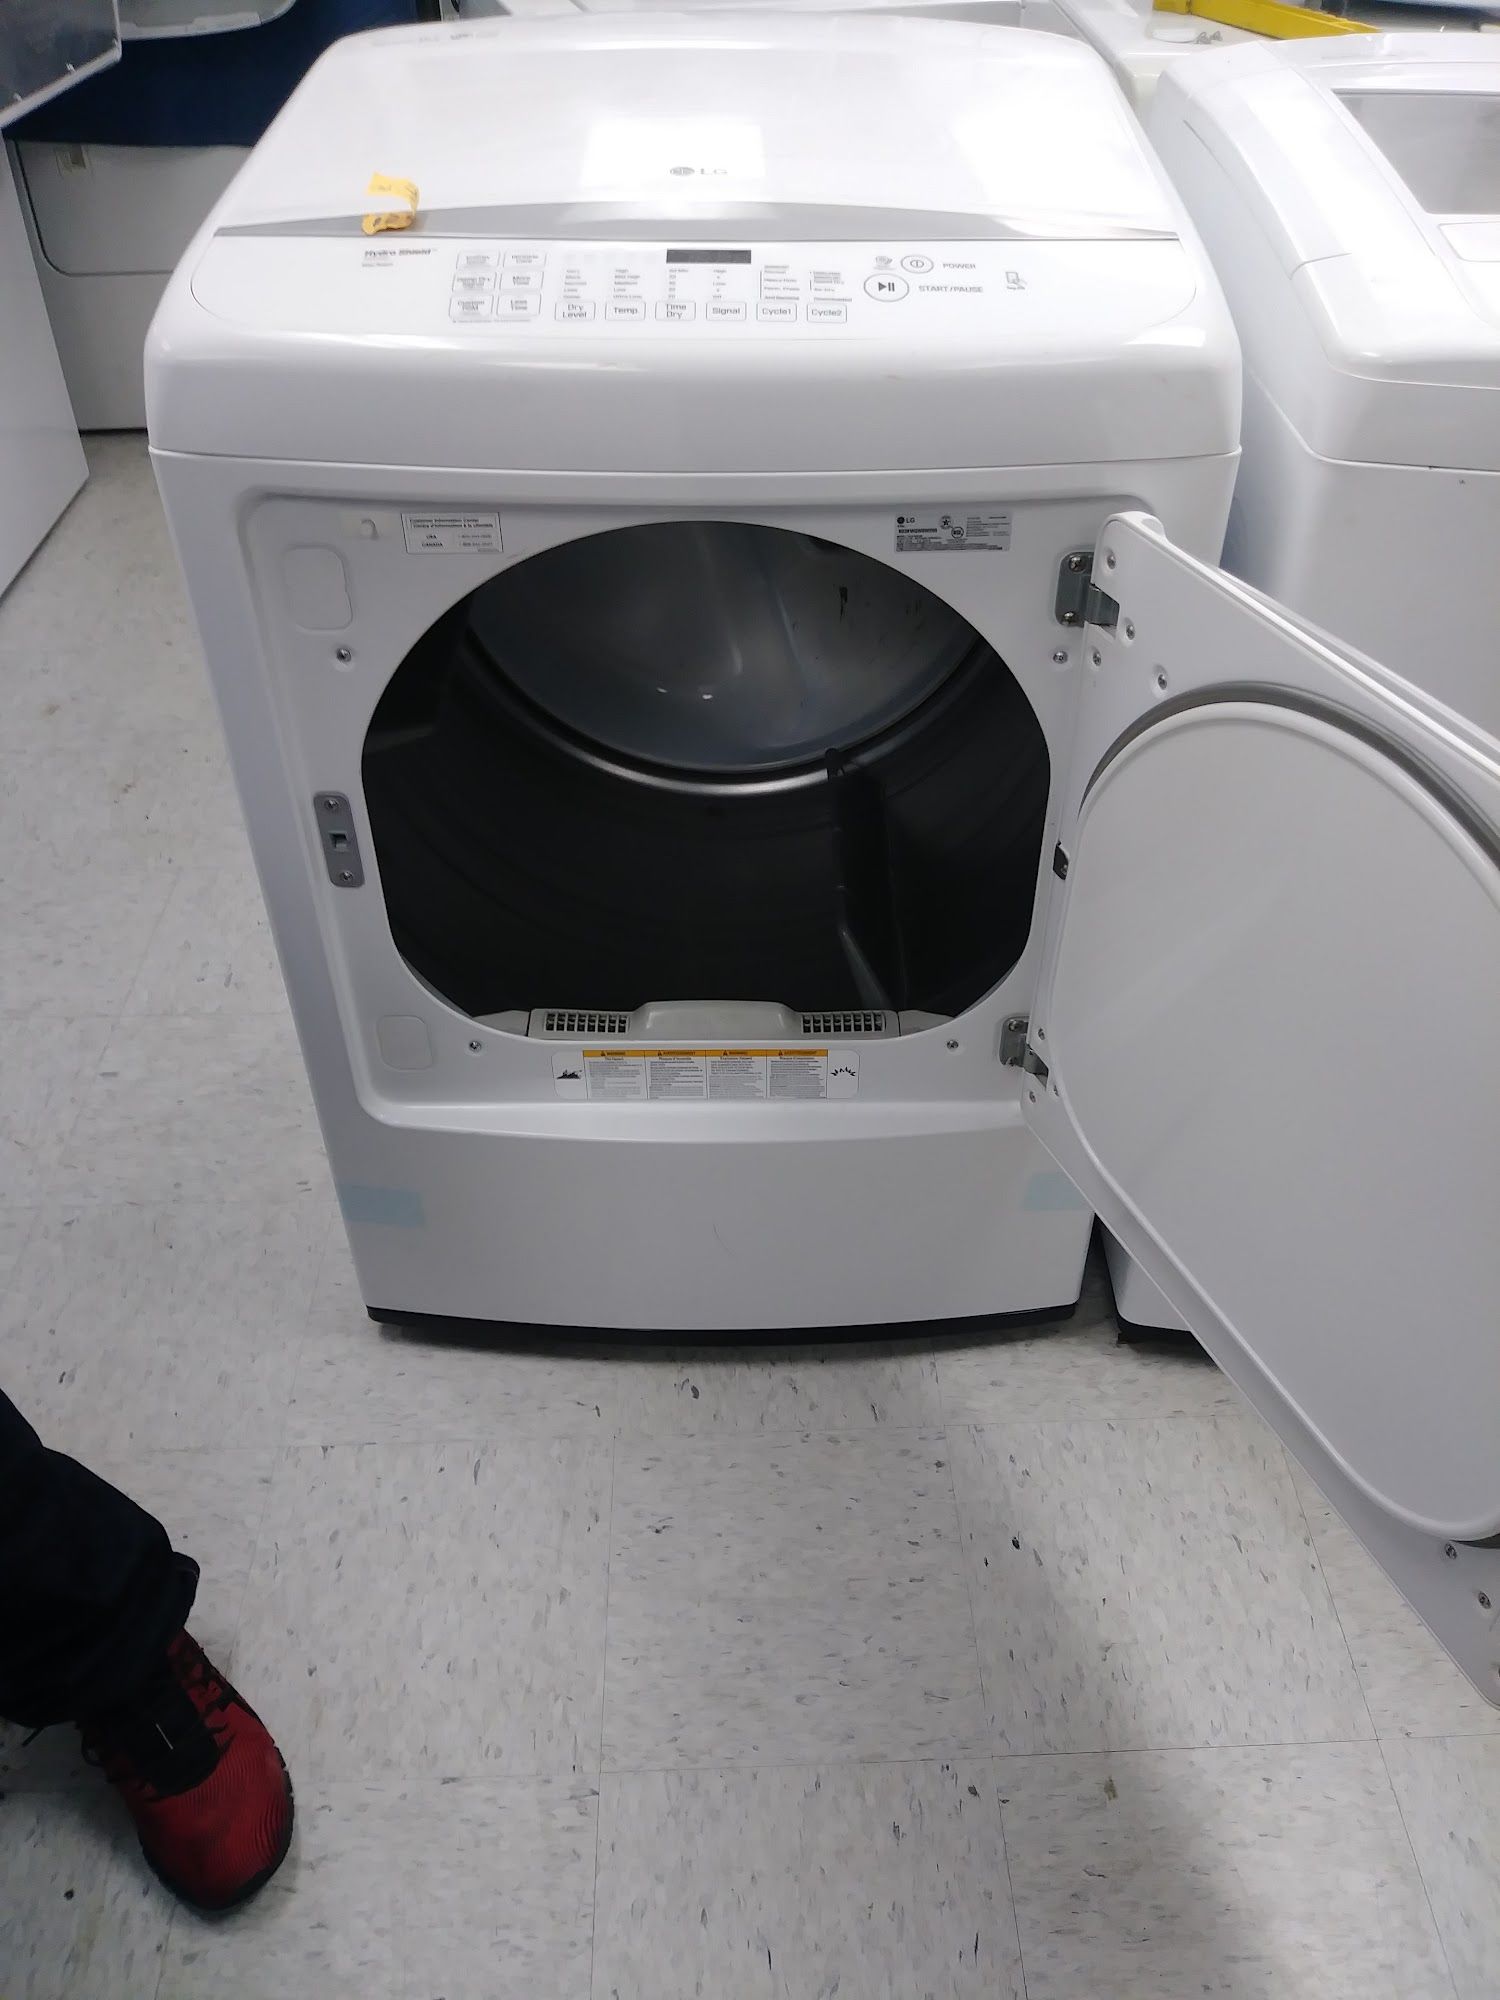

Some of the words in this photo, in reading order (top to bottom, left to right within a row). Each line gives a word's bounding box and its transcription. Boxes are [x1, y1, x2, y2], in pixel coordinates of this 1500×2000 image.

[700, 168, 728, 176] LG
[943, 262, 976, 270] POWER
[918, 284, 984, 294] START/PAUSE
[567, 303, 584, 312] Dry
[665, 303, 687, 311] Time
[711, 306, 741, 317] Signal
[562, 310, 588, 318] Level
[665, 310, 683, 320] Dry
[761, 307, 793, 318] Cycle1
[811, 308, 843, 319] Cycle2
